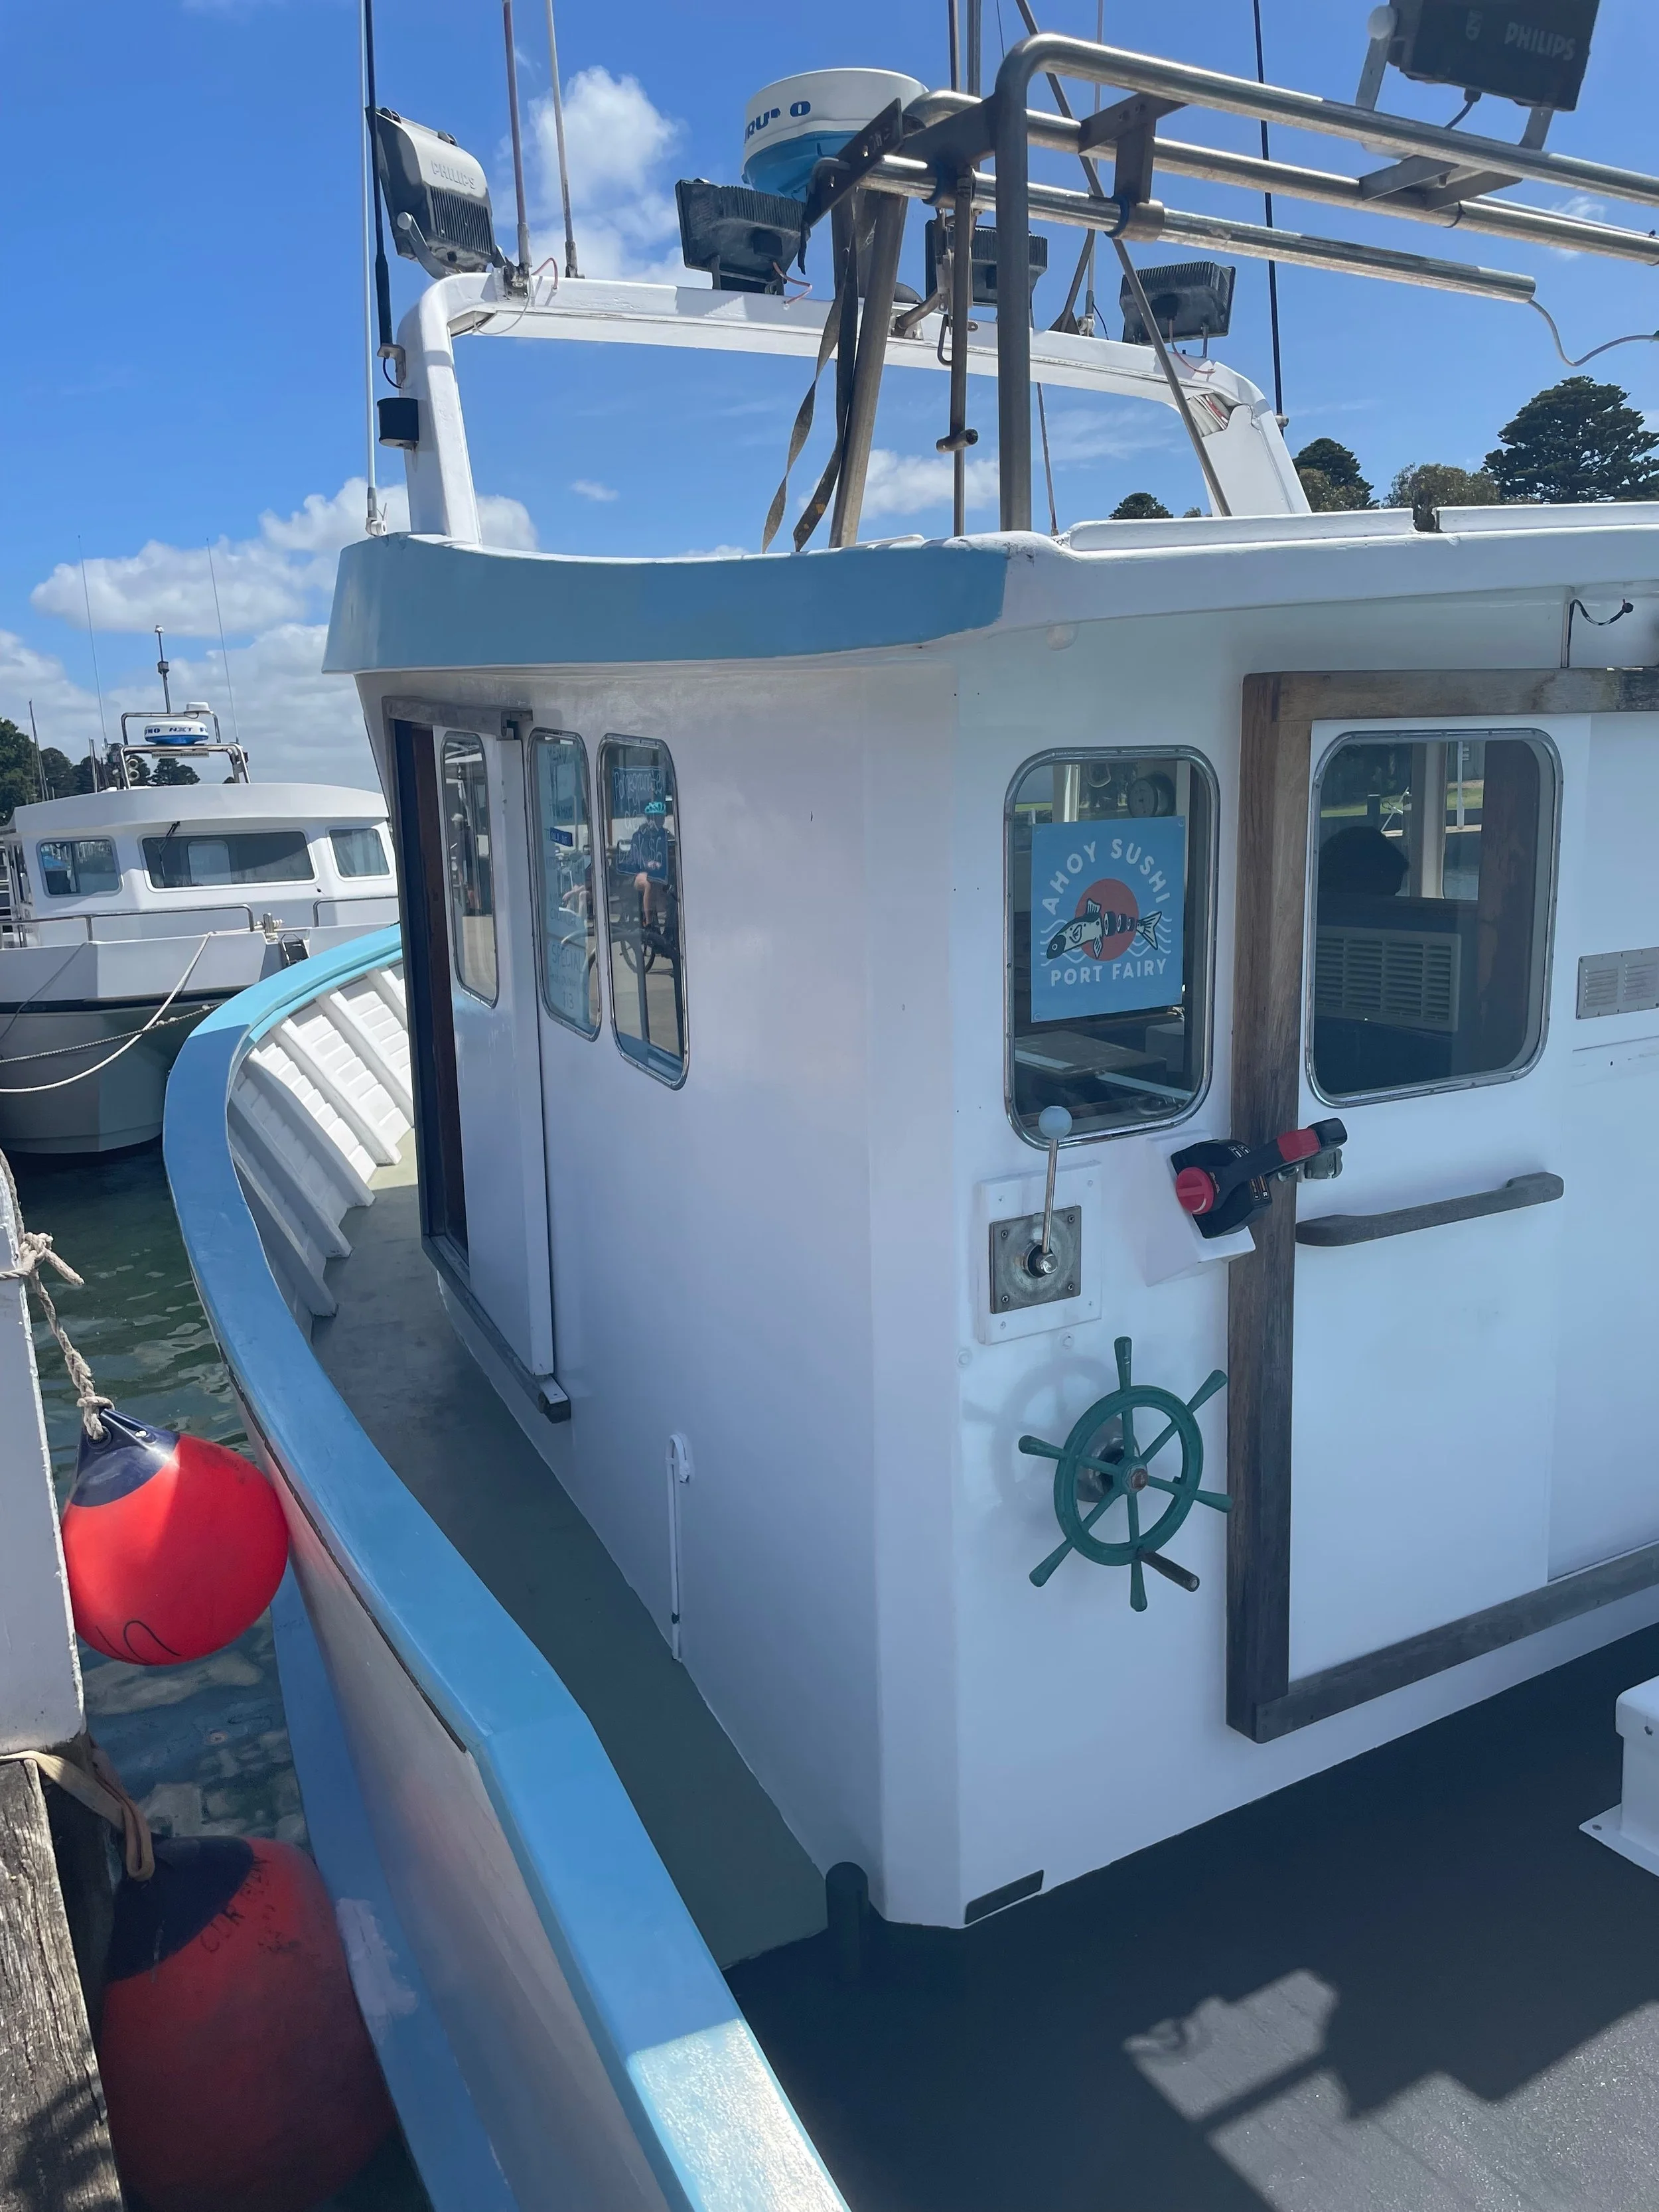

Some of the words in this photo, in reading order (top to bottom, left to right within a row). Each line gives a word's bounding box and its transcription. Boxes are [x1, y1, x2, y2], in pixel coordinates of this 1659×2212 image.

[1504, 21, 1575, 60] PHILIPS
[430, 160, 476, 190] PHILIPS
[1042, 841, 1096, 916] AHOY
[1110, 838, 1171, 903] SUSHI
[1050, 965, 1103, 987] PORT
[1112, 958, 1167, 981] FAIRY
